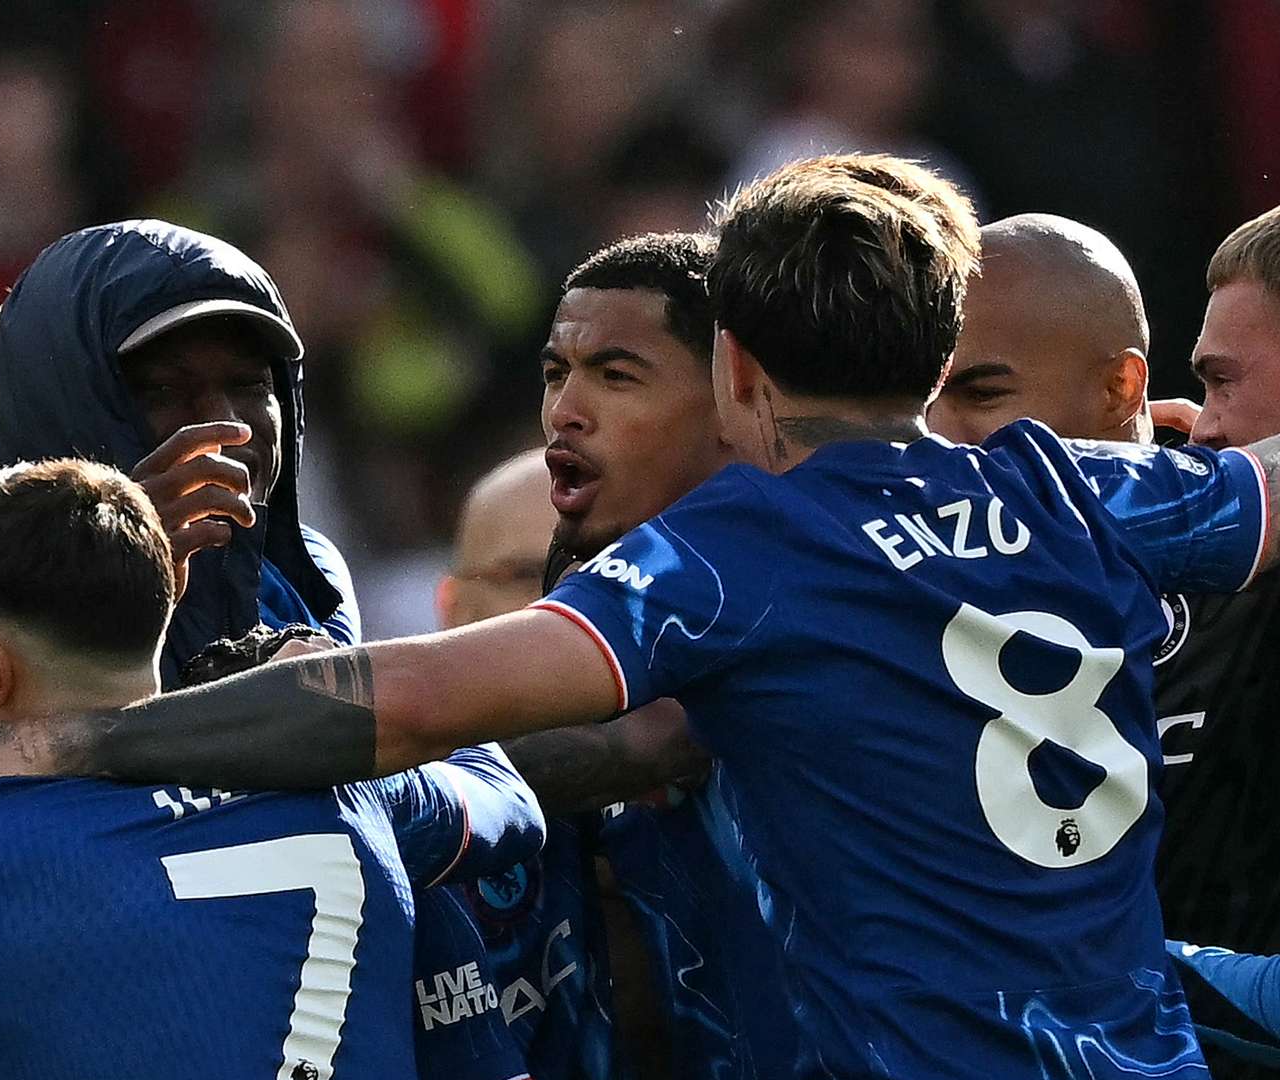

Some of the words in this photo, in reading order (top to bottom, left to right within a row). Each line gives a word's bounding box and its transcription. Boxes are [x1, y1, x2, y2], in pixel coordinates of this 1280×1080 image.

[861, 496, 1032, 571] ENZO
[942, 602, 1149, 868] 8
[415, 961, 483, 1005] LIVE
[420, 982, 499, 1031] NATIO
